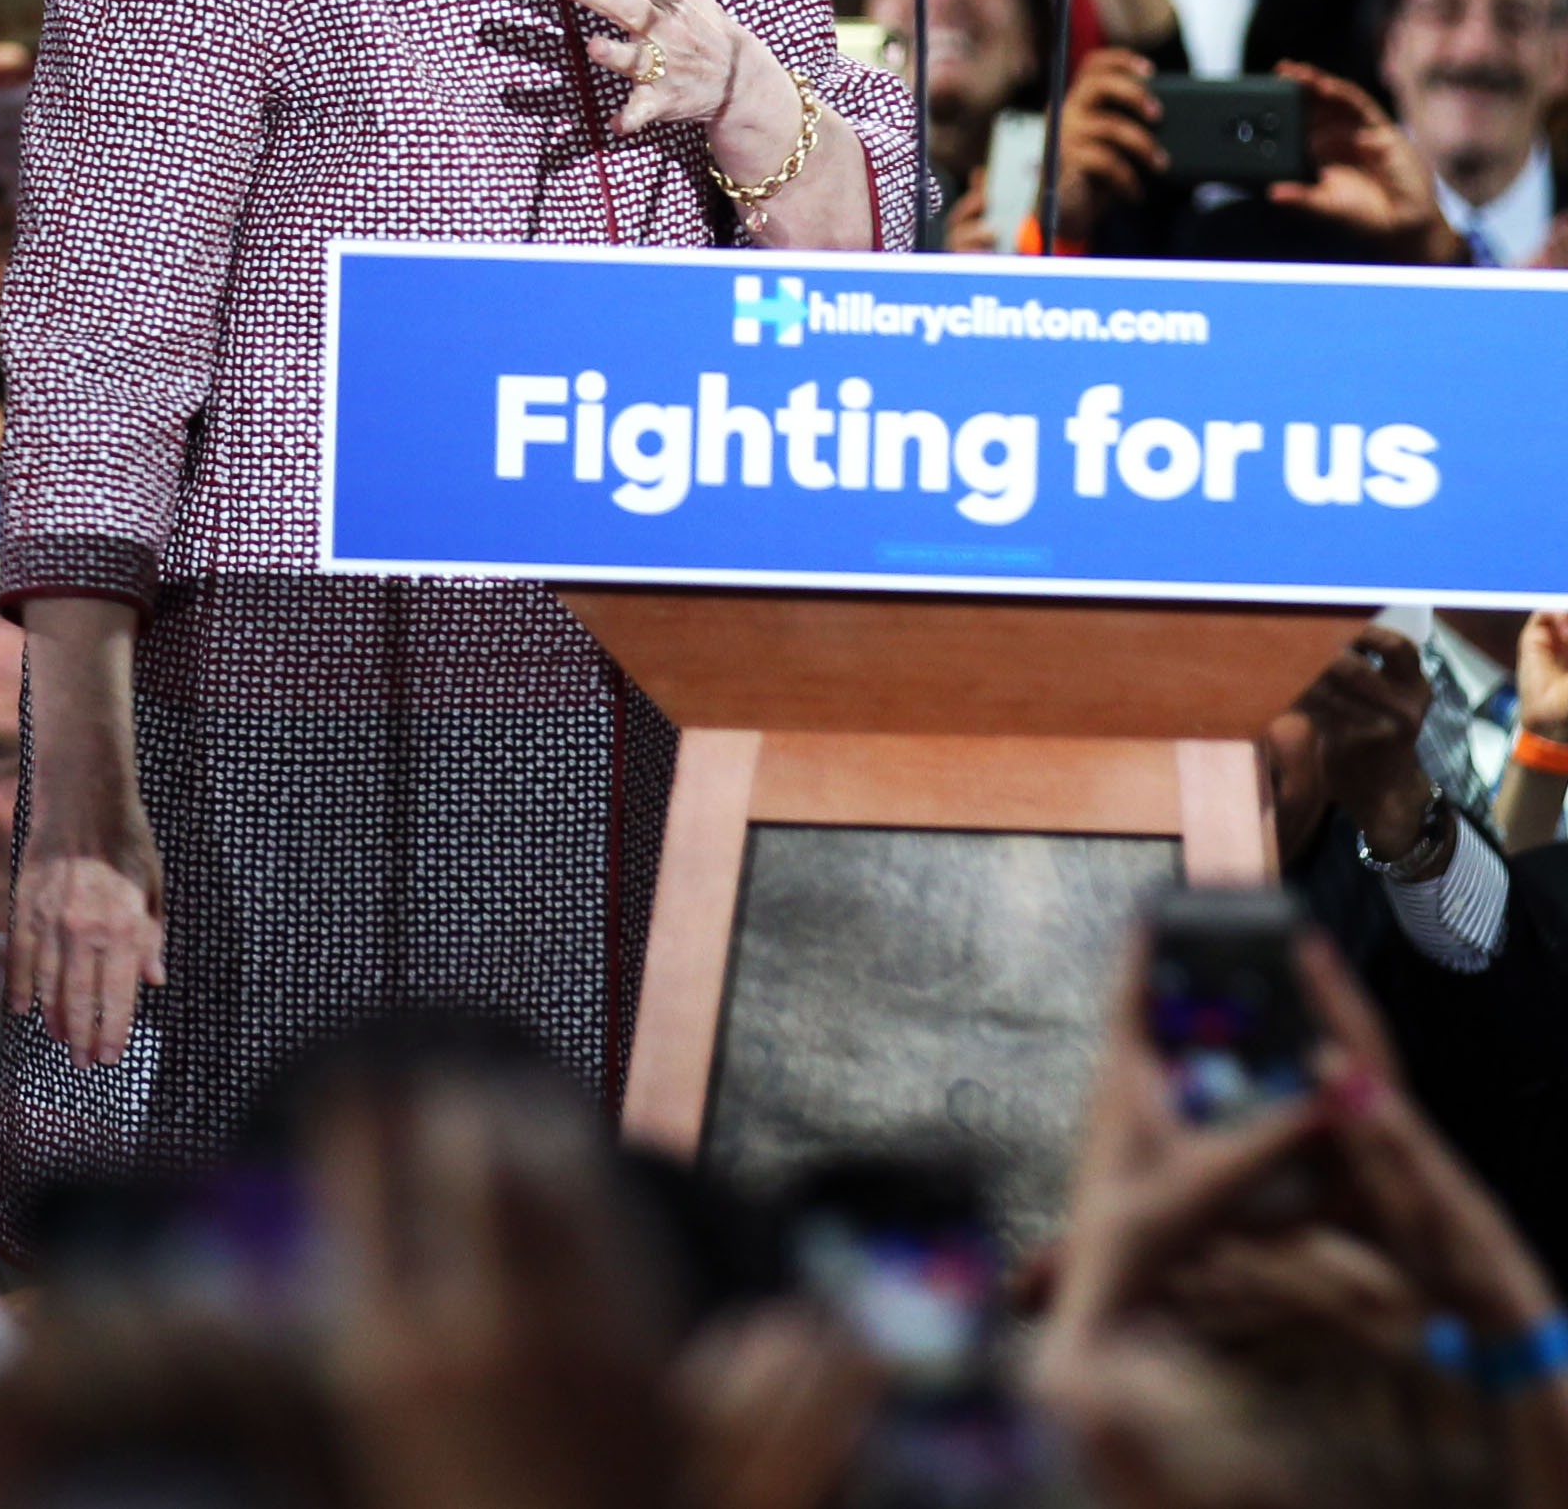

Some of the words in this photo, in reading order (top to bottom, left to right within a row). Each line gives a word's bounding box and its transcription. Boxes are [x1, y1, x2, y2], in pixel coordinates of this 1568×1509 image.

[808, 290, 1210, 345] hillaryclinton.com
[495, 370, 1039, 525] Fighting
[1064, 383, 1264, 501] for
[1284, 421, 1439, 508] us
